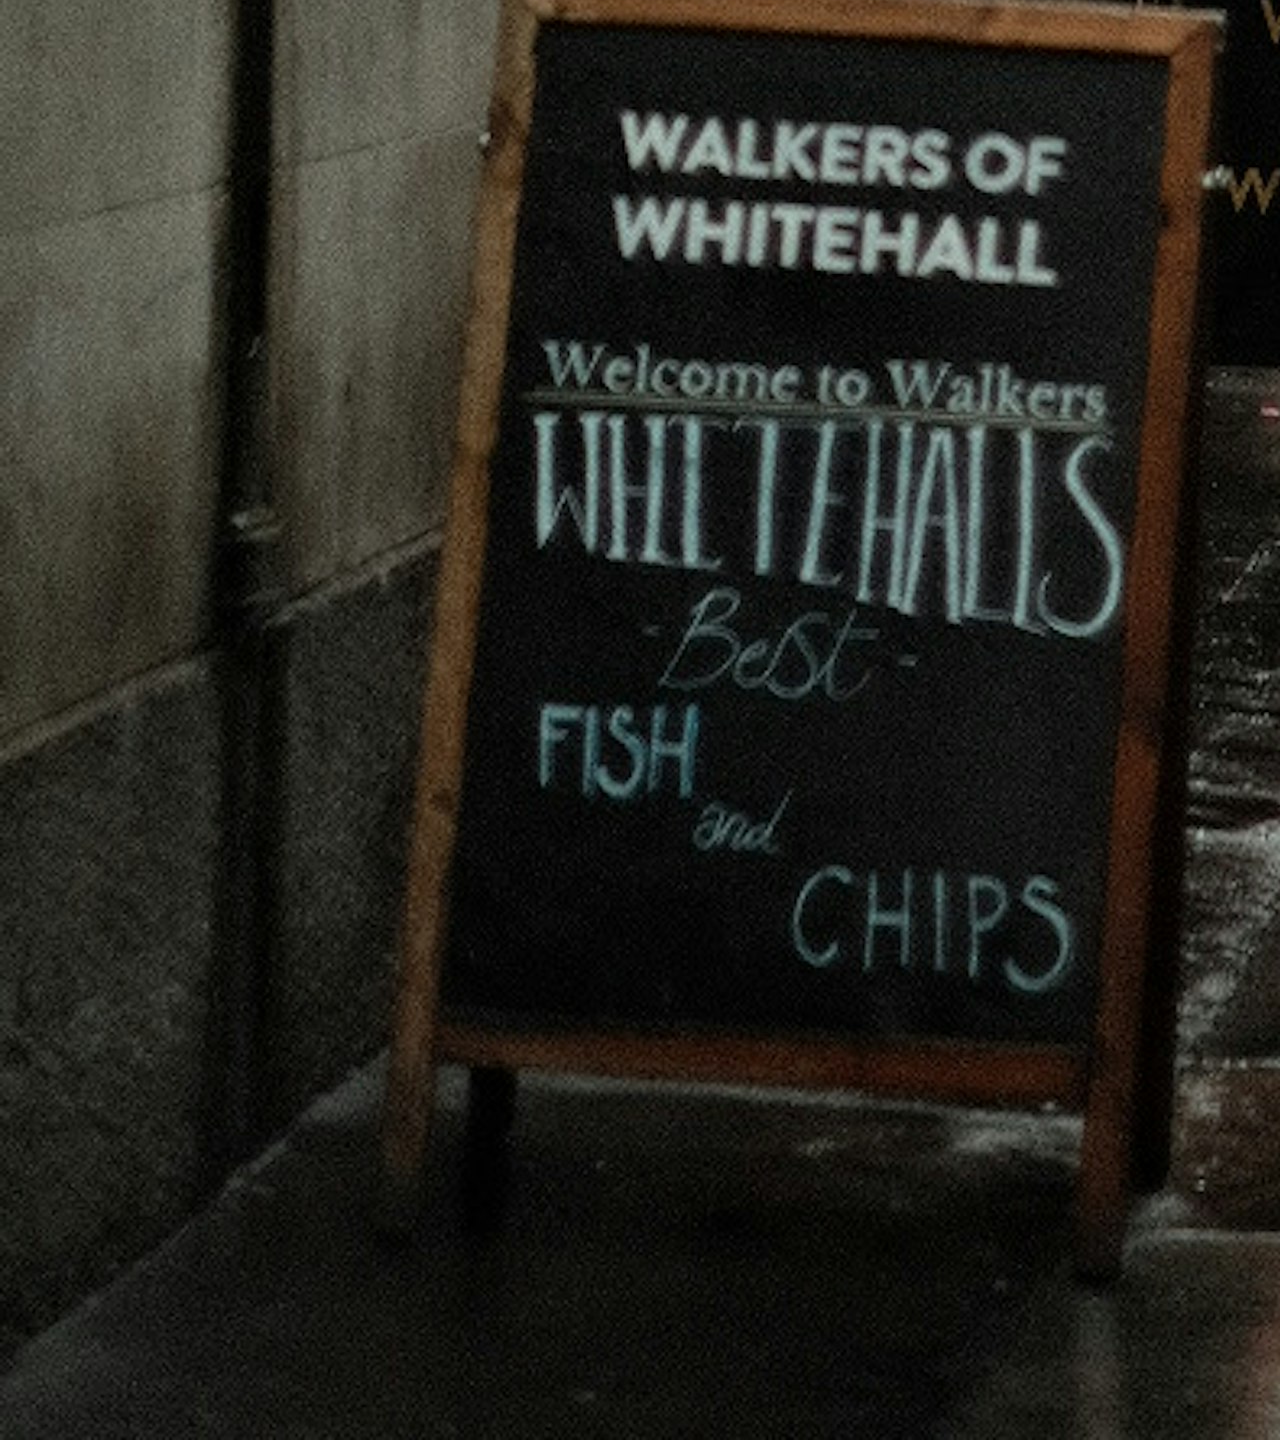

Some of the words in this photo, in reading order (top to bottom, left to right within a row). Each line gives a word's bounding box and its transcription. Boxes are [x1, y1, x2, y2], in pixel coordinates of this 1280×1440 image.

[619, 109, 953, 190] WALKERS
[963, 131, 1069, 197] OF
[612, 193, 1059, 288] WHITEHALL
[541, 338, 803, 405] Welcome
[819, 362, 870, 407] to
[887, 359, 1107, 422] Walkers
[539, 702, 700, 799] FISH
[693, 788, 795, 854] and
[793, 864, 1076, 992] CHIPS
